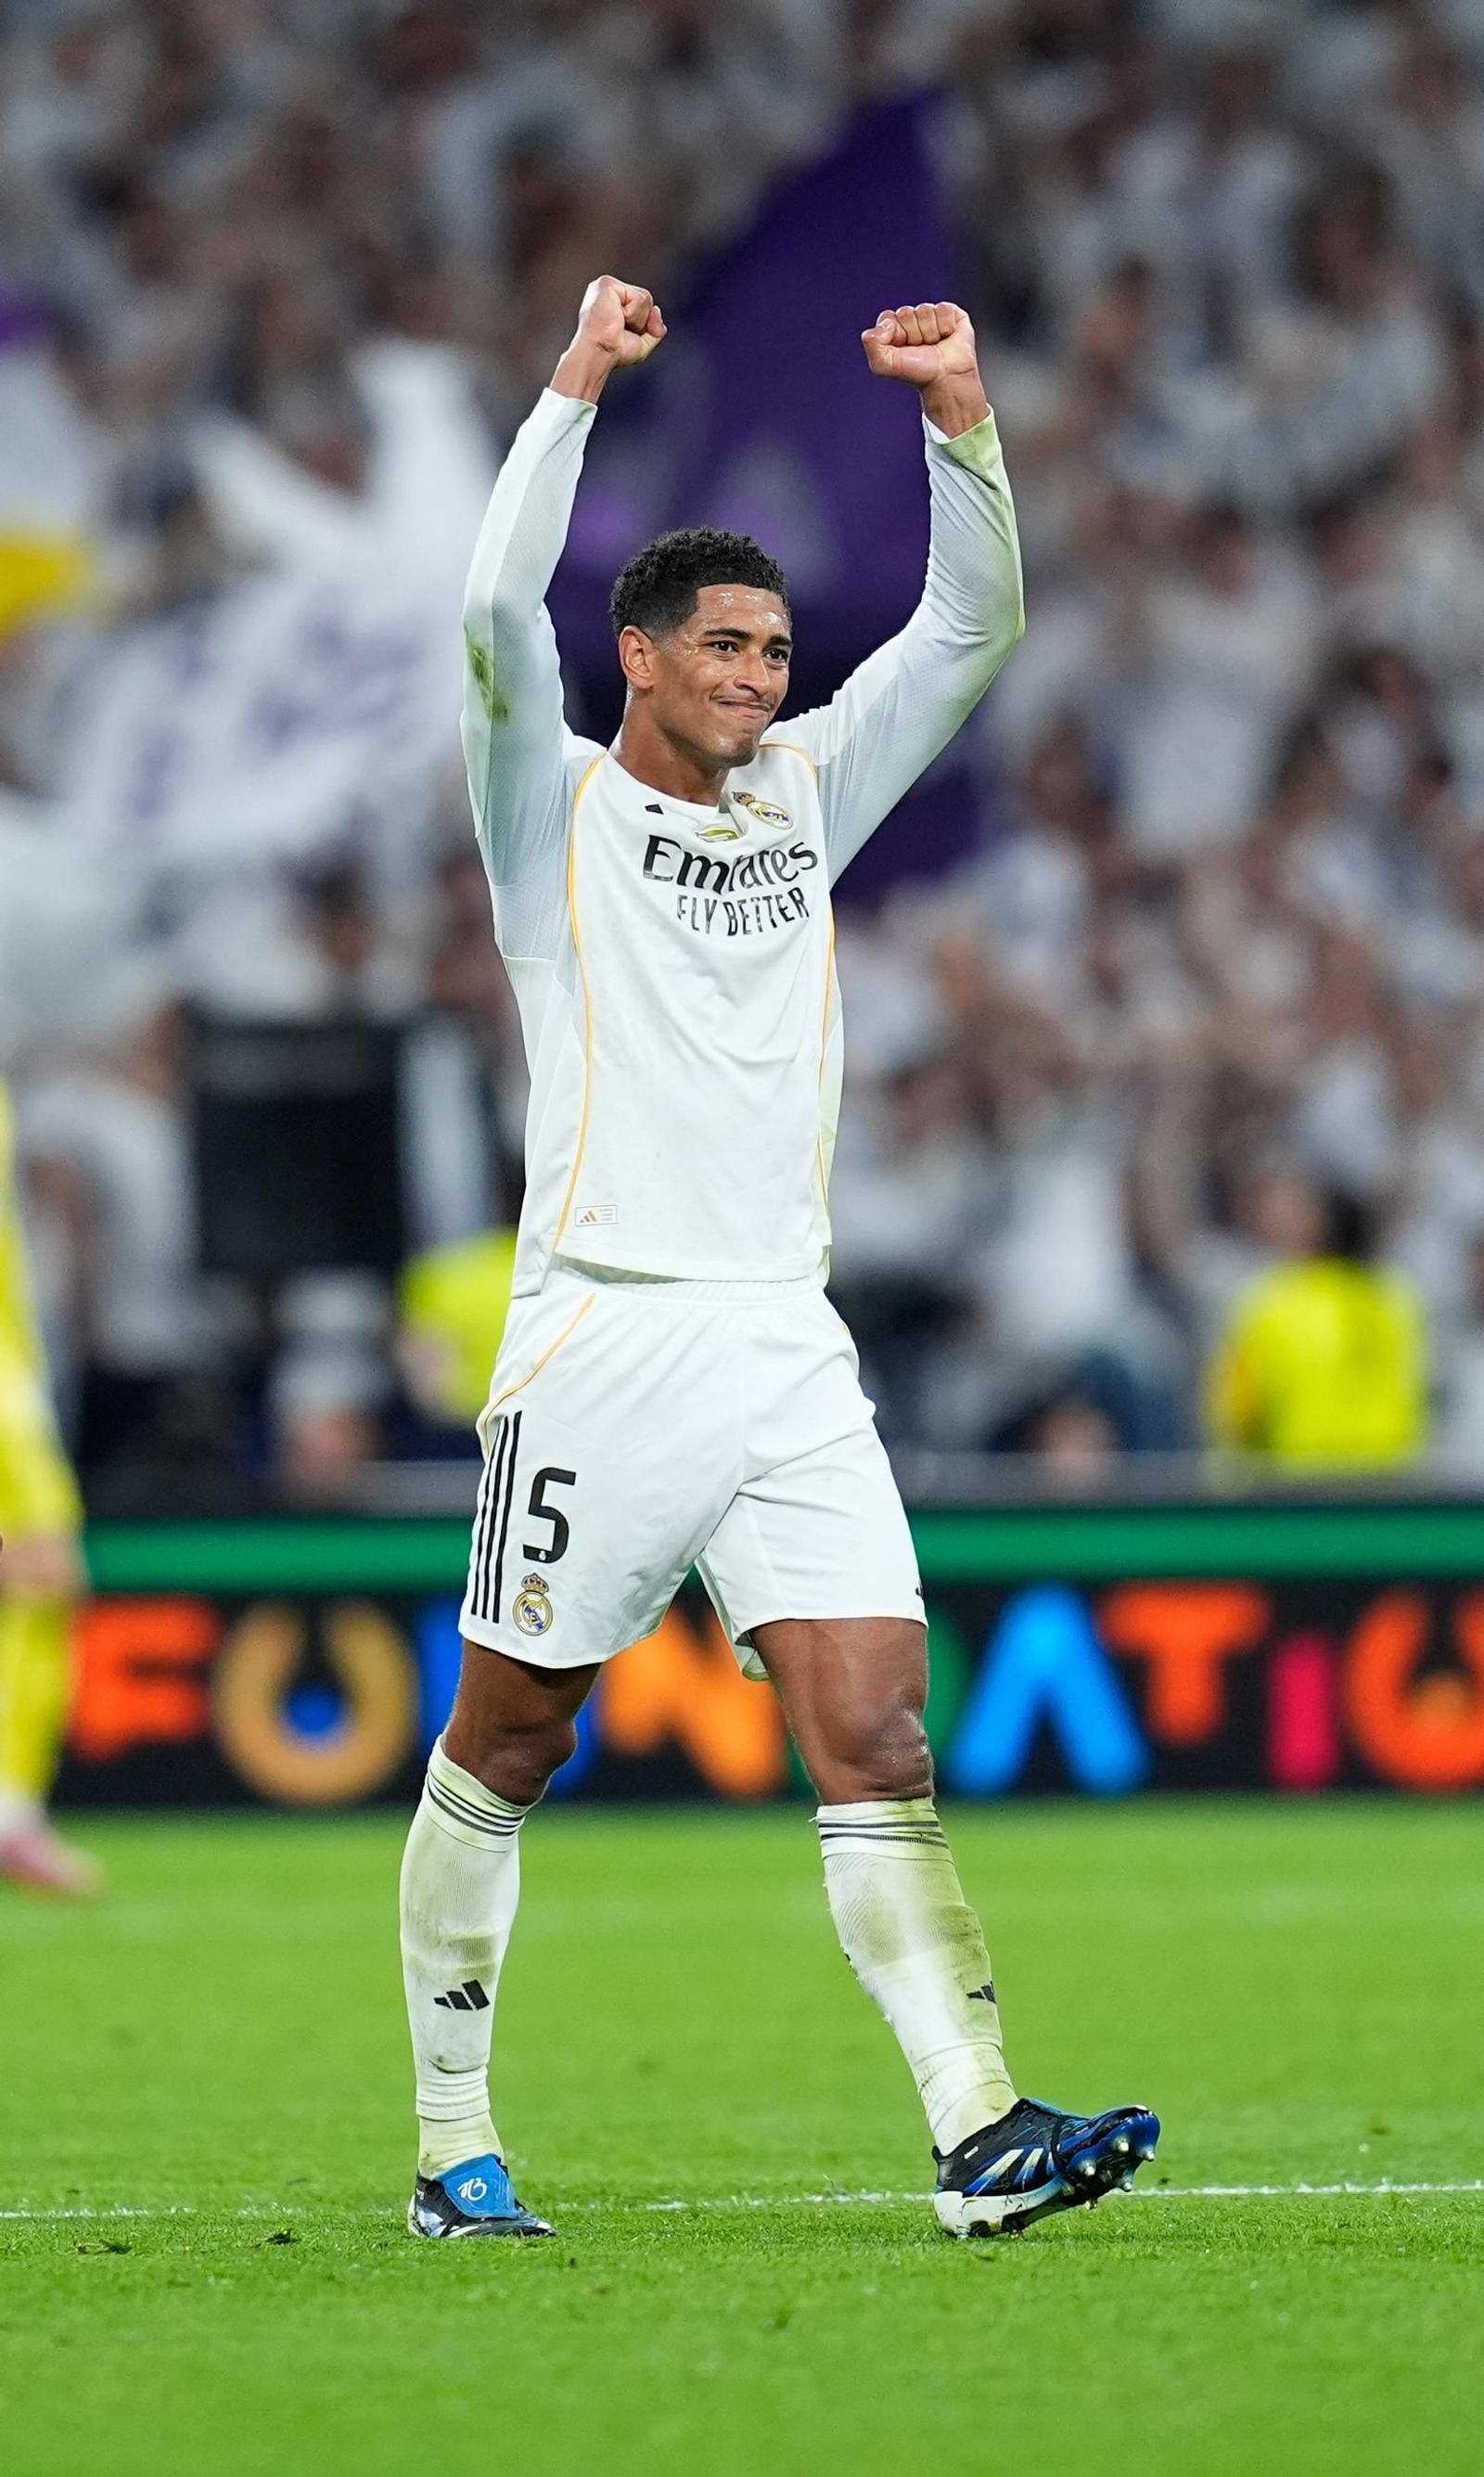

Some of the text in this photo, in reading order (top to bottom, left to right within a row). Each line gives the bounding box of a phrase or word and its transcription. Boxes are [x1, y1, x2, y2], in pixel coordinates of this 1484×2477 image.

[643, 834, 818, 895] Emrates
[676, 887, 810, 937] FLY BETTER
[522, 1466, 577, 1564] 5
